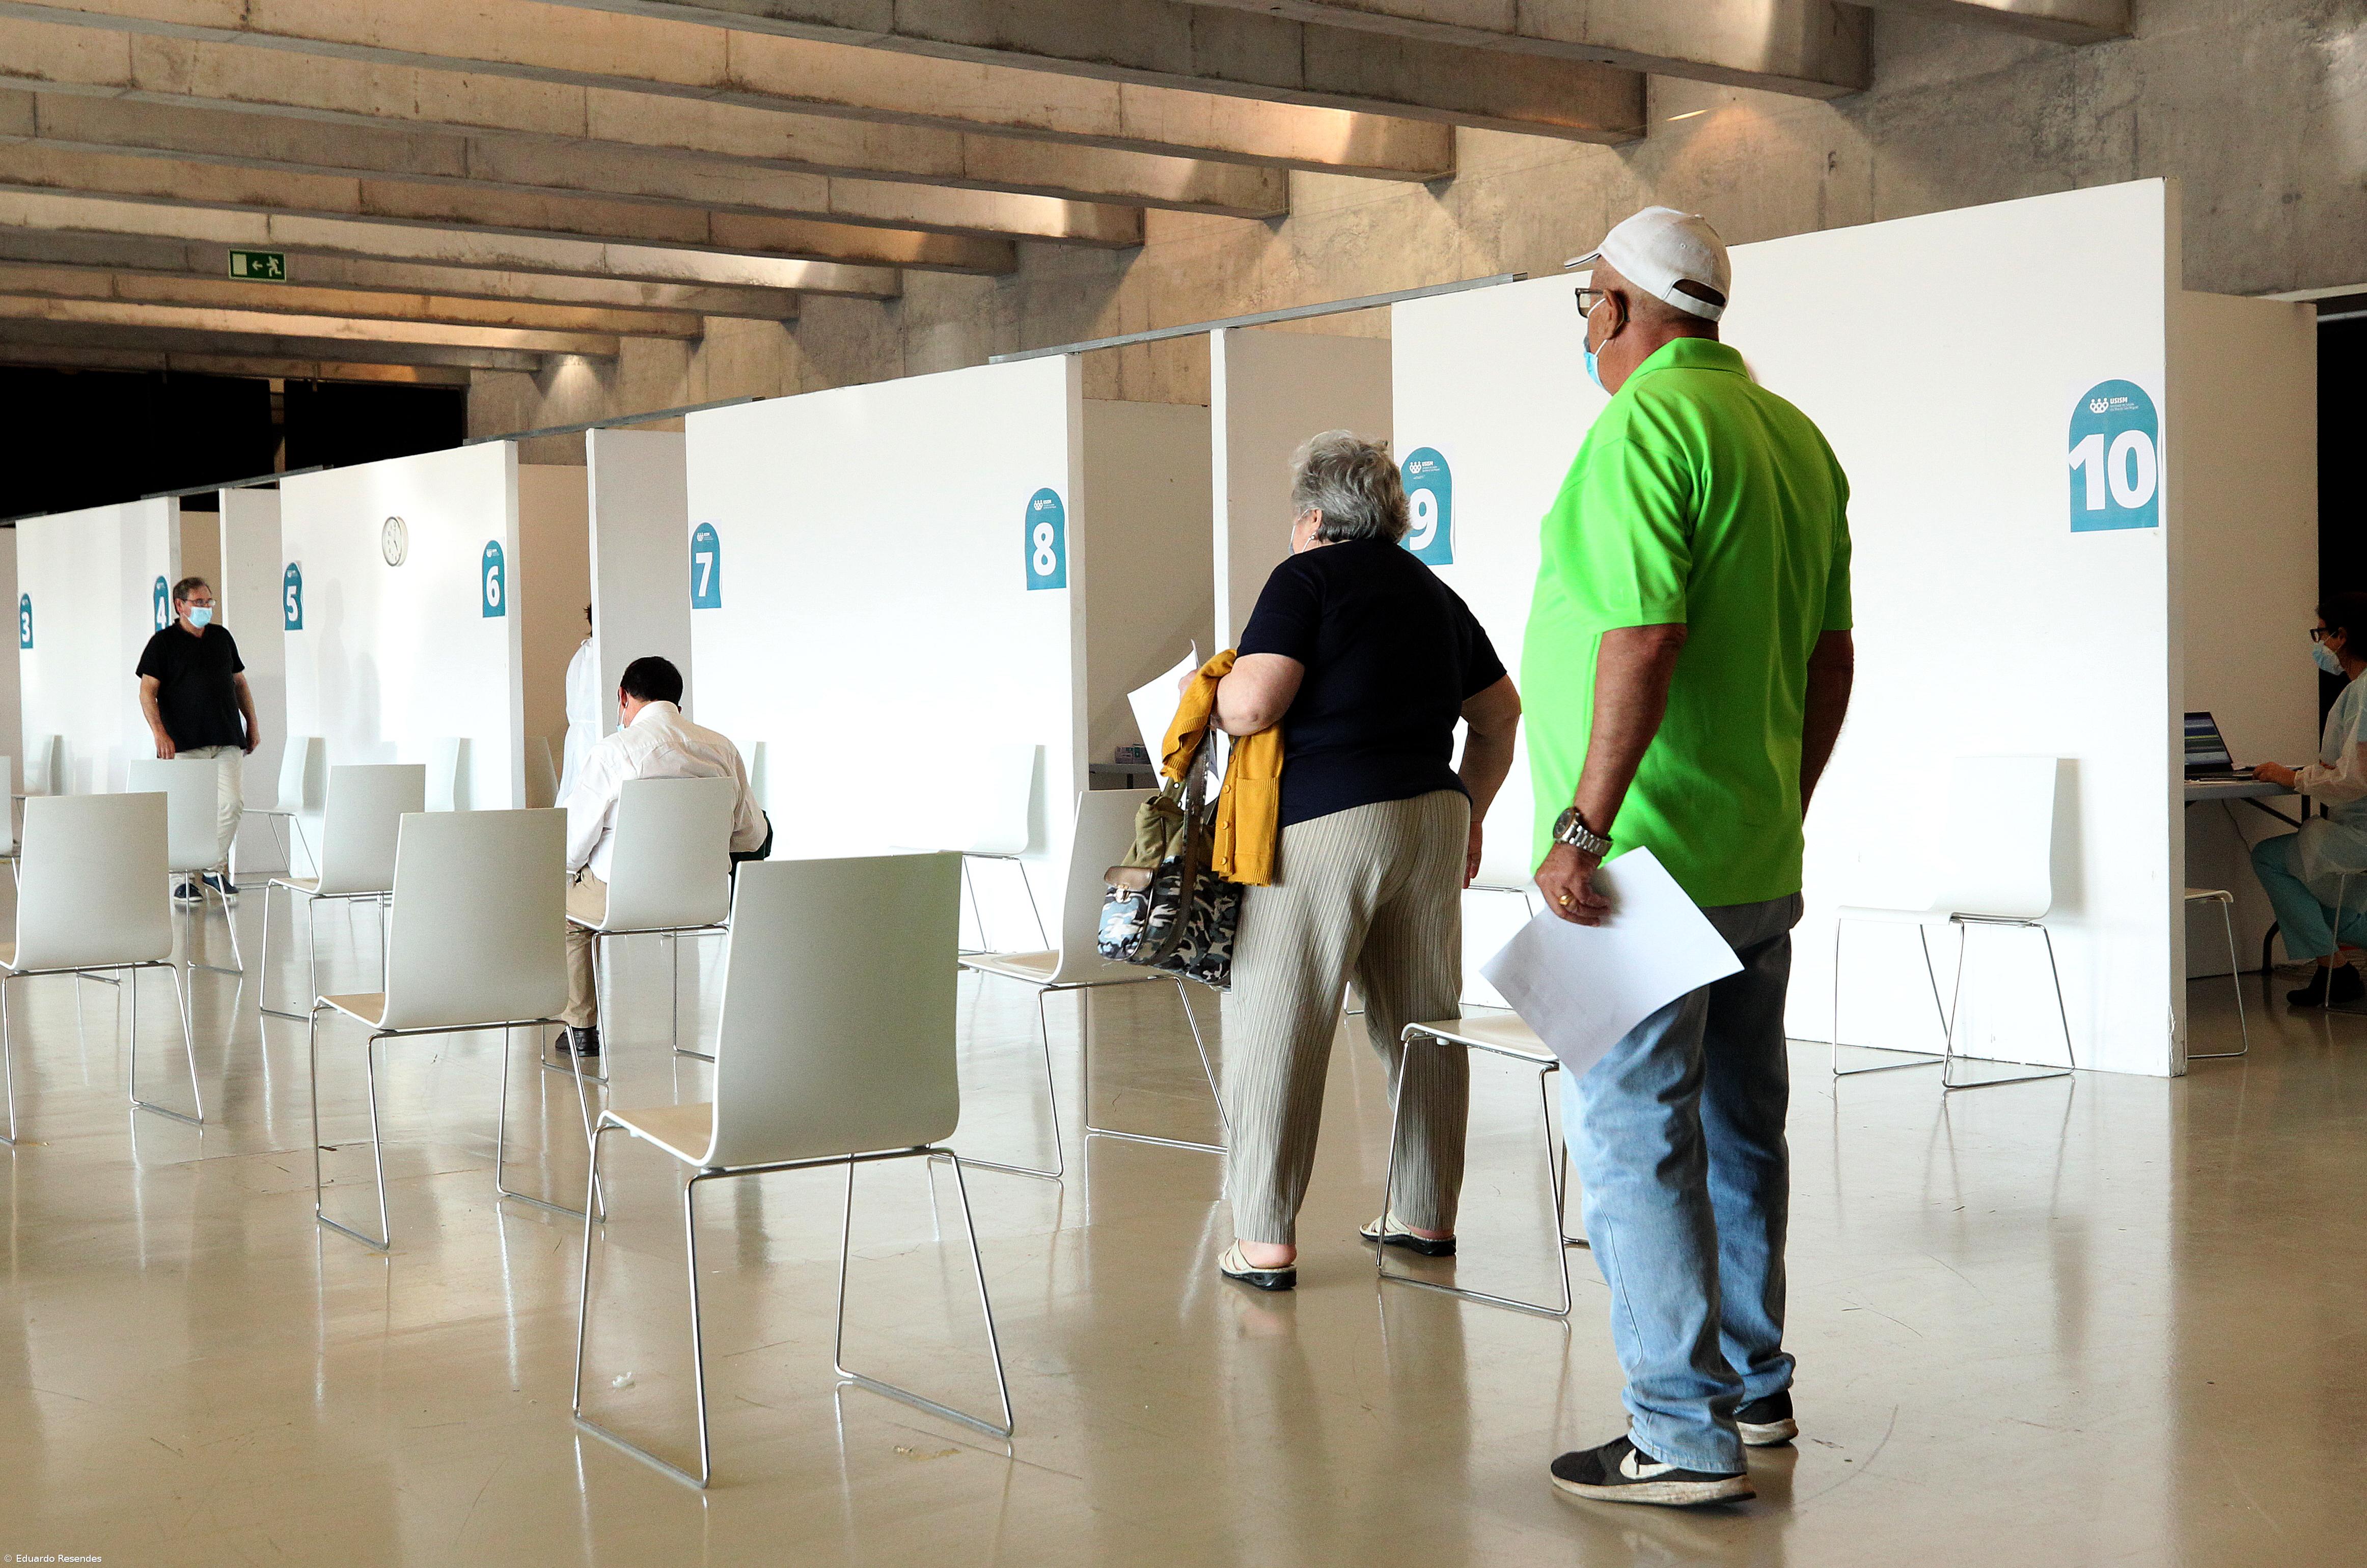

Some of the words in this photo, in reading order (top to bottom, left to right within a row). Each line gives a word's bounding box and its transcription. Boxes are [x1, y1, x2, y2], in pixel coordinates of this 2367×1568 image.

[2068, 430, 2157, 511] 10
[1409, 488, 1439, 550] 9
[1033, 522, 1057, 576] 8
[486, 566, 500, 607] 6
[696, 551, 713, 597] 7
[156, 596, 167, 629] 4
[287, 585, 298, 622] 5
[22, 611, 31, 642] 3
